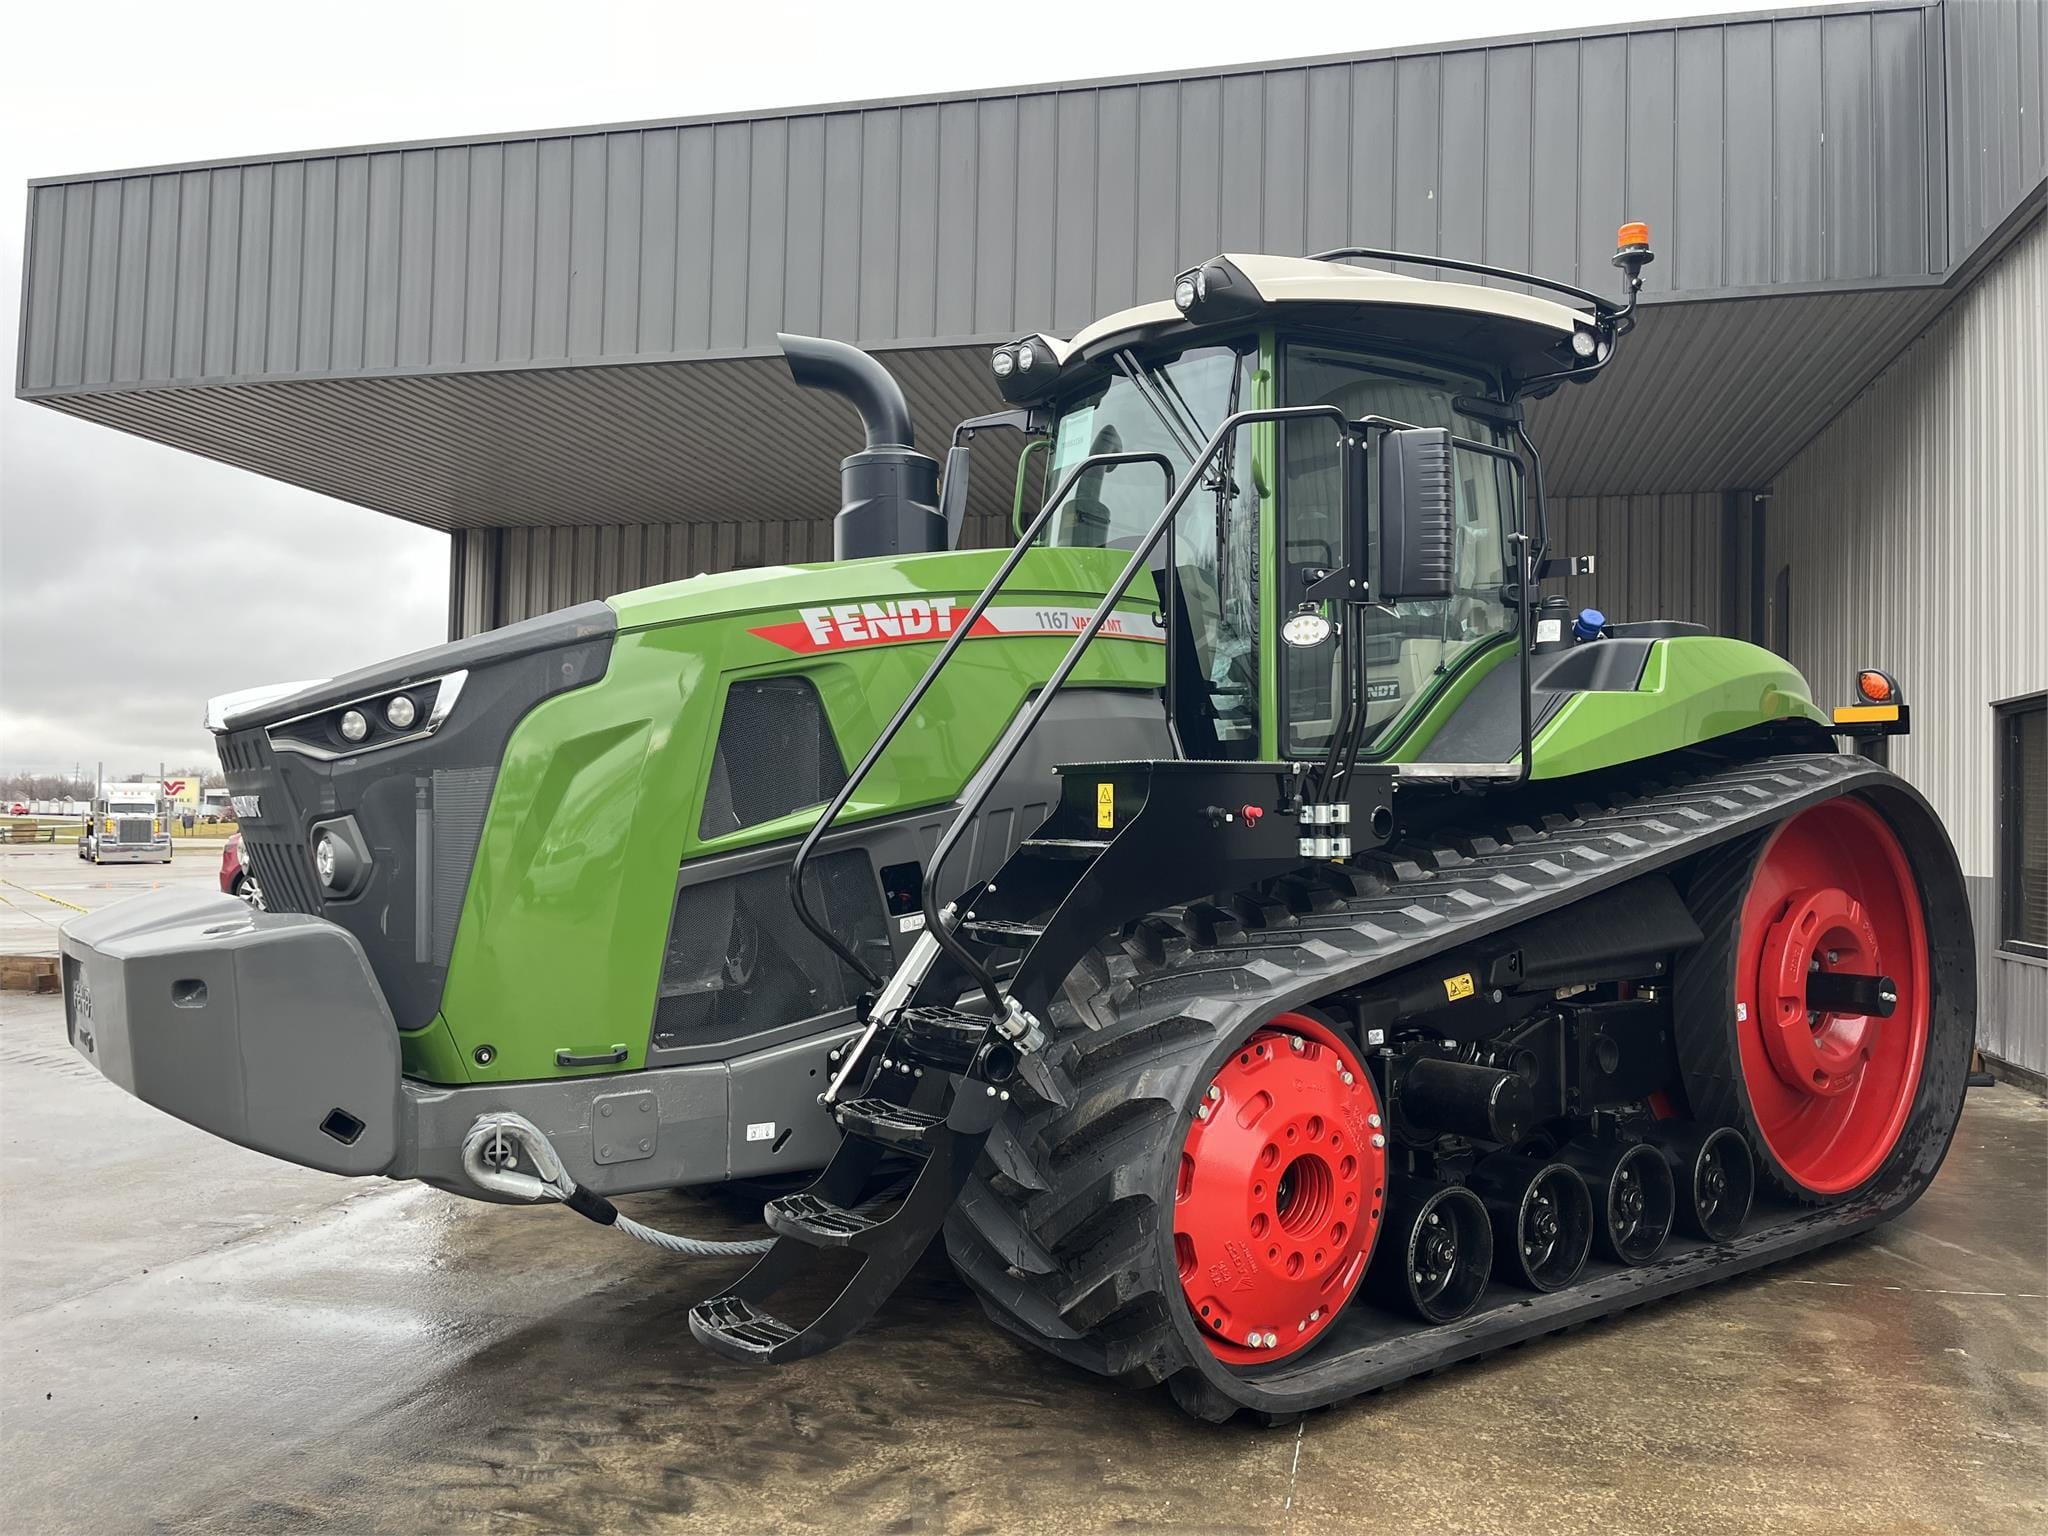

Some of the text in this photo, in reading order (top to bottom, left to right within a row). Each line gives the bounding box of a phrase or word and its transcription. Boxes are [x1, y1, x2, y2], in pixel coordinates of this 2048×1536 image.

[798, 597, 956, 646] FENDT
[1035, 611, 1069, 630] 1167
[1106, 618, 1122, 633] MT
[1367, 684, 1398, 698] NDT
